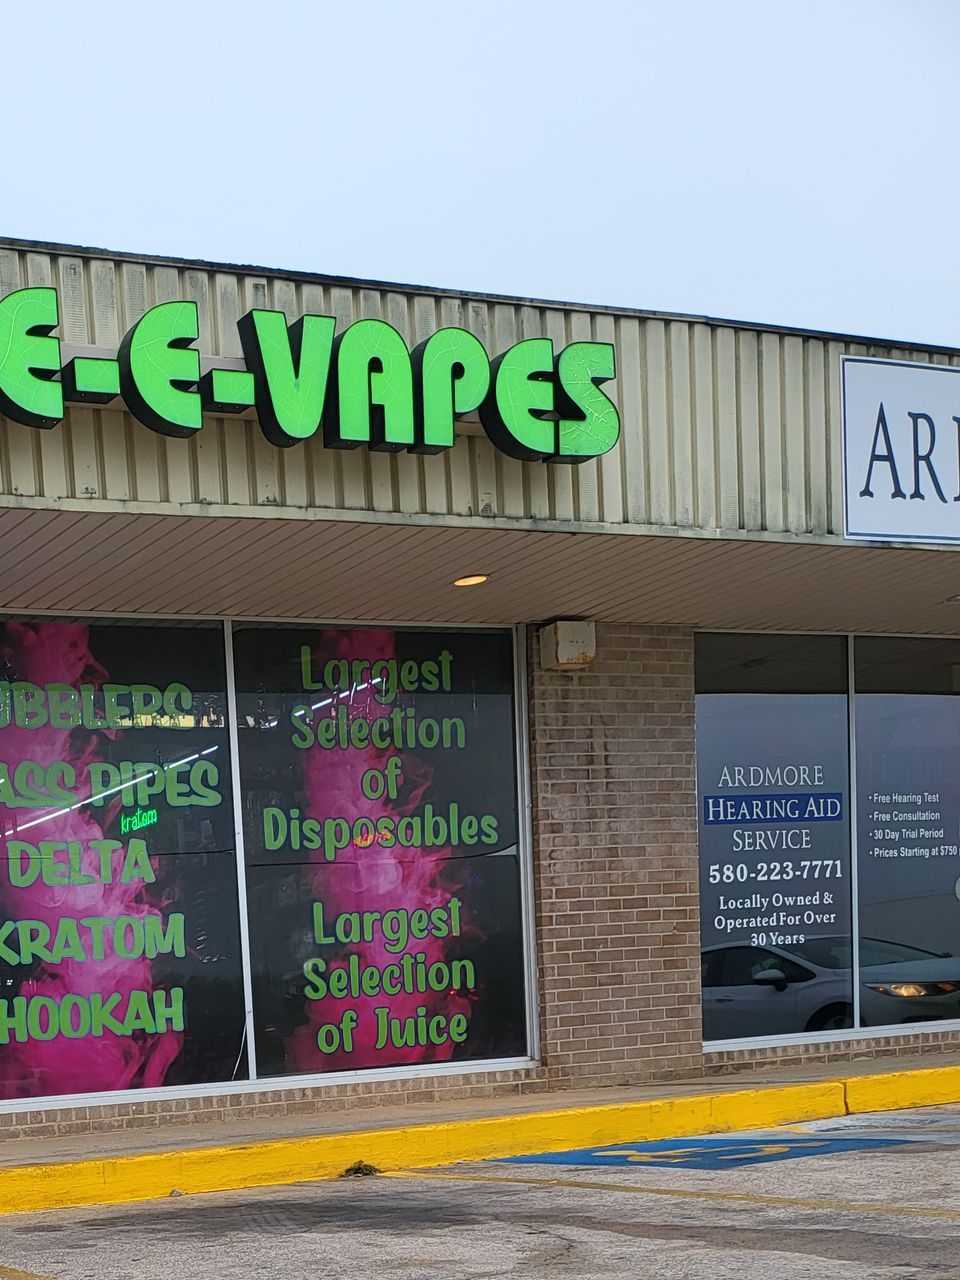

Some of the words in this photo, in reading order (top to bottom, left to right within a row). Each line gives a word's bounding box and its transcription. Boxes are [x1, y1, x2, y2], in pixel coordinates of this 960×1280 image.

[300, 644, 455, 703] Largest
[290, 704, 466, 751] Selection
[87, 760, 223, 808] PIPES
[360, 755, 403, 800] of
[718, 765, 824, 787] ARDMORE
[707, 797, 800, 821] HEARING
[803, 796, 841, 819] AID
[873, 793, 891, 803] Free
[892, 793, 922, 805] Hearing
[923, 792, 940, 803] Test
[121, 807, 157, 834] kratom
[873, 811, 891, 821] Free
[892, 810, 941, 821] Consultation
[262, 802, 501, 862] Disposables
[732, 829, 812, 851] SERVICE
[873, 829, 883, 840] 30
[884, 829, 900, 842] Day
[901, 828, 918, 839] Trial
[919, 827, 944, 838] Period
[7, 838, 156, 887] DELTA
[874, 847, 898, 858] Prices
[899, 846, 930, 859] Starting
[931, 847, 939, 856] at
[940, 845, 958, 856] $750
[708, 859, 843, 884] 580-223-7771
[719, 894, 770, 912] Locally
[772, 891, 820, 907] Owned
[823, 891, 834, 905] &
[312, 897, 463, 953] Largest
[714, 912, 777, 933] Operated
[779, 912, 801, 926] For
[803, 910, 837, 925] Over
[750, 932, 767, 947] 30
[769, 932, 806, 946] Years
[302, 952, 477, 1001] Selection
[316, 1009, 360, 1055] of
[374, 1005, 470, 1050] Juice
